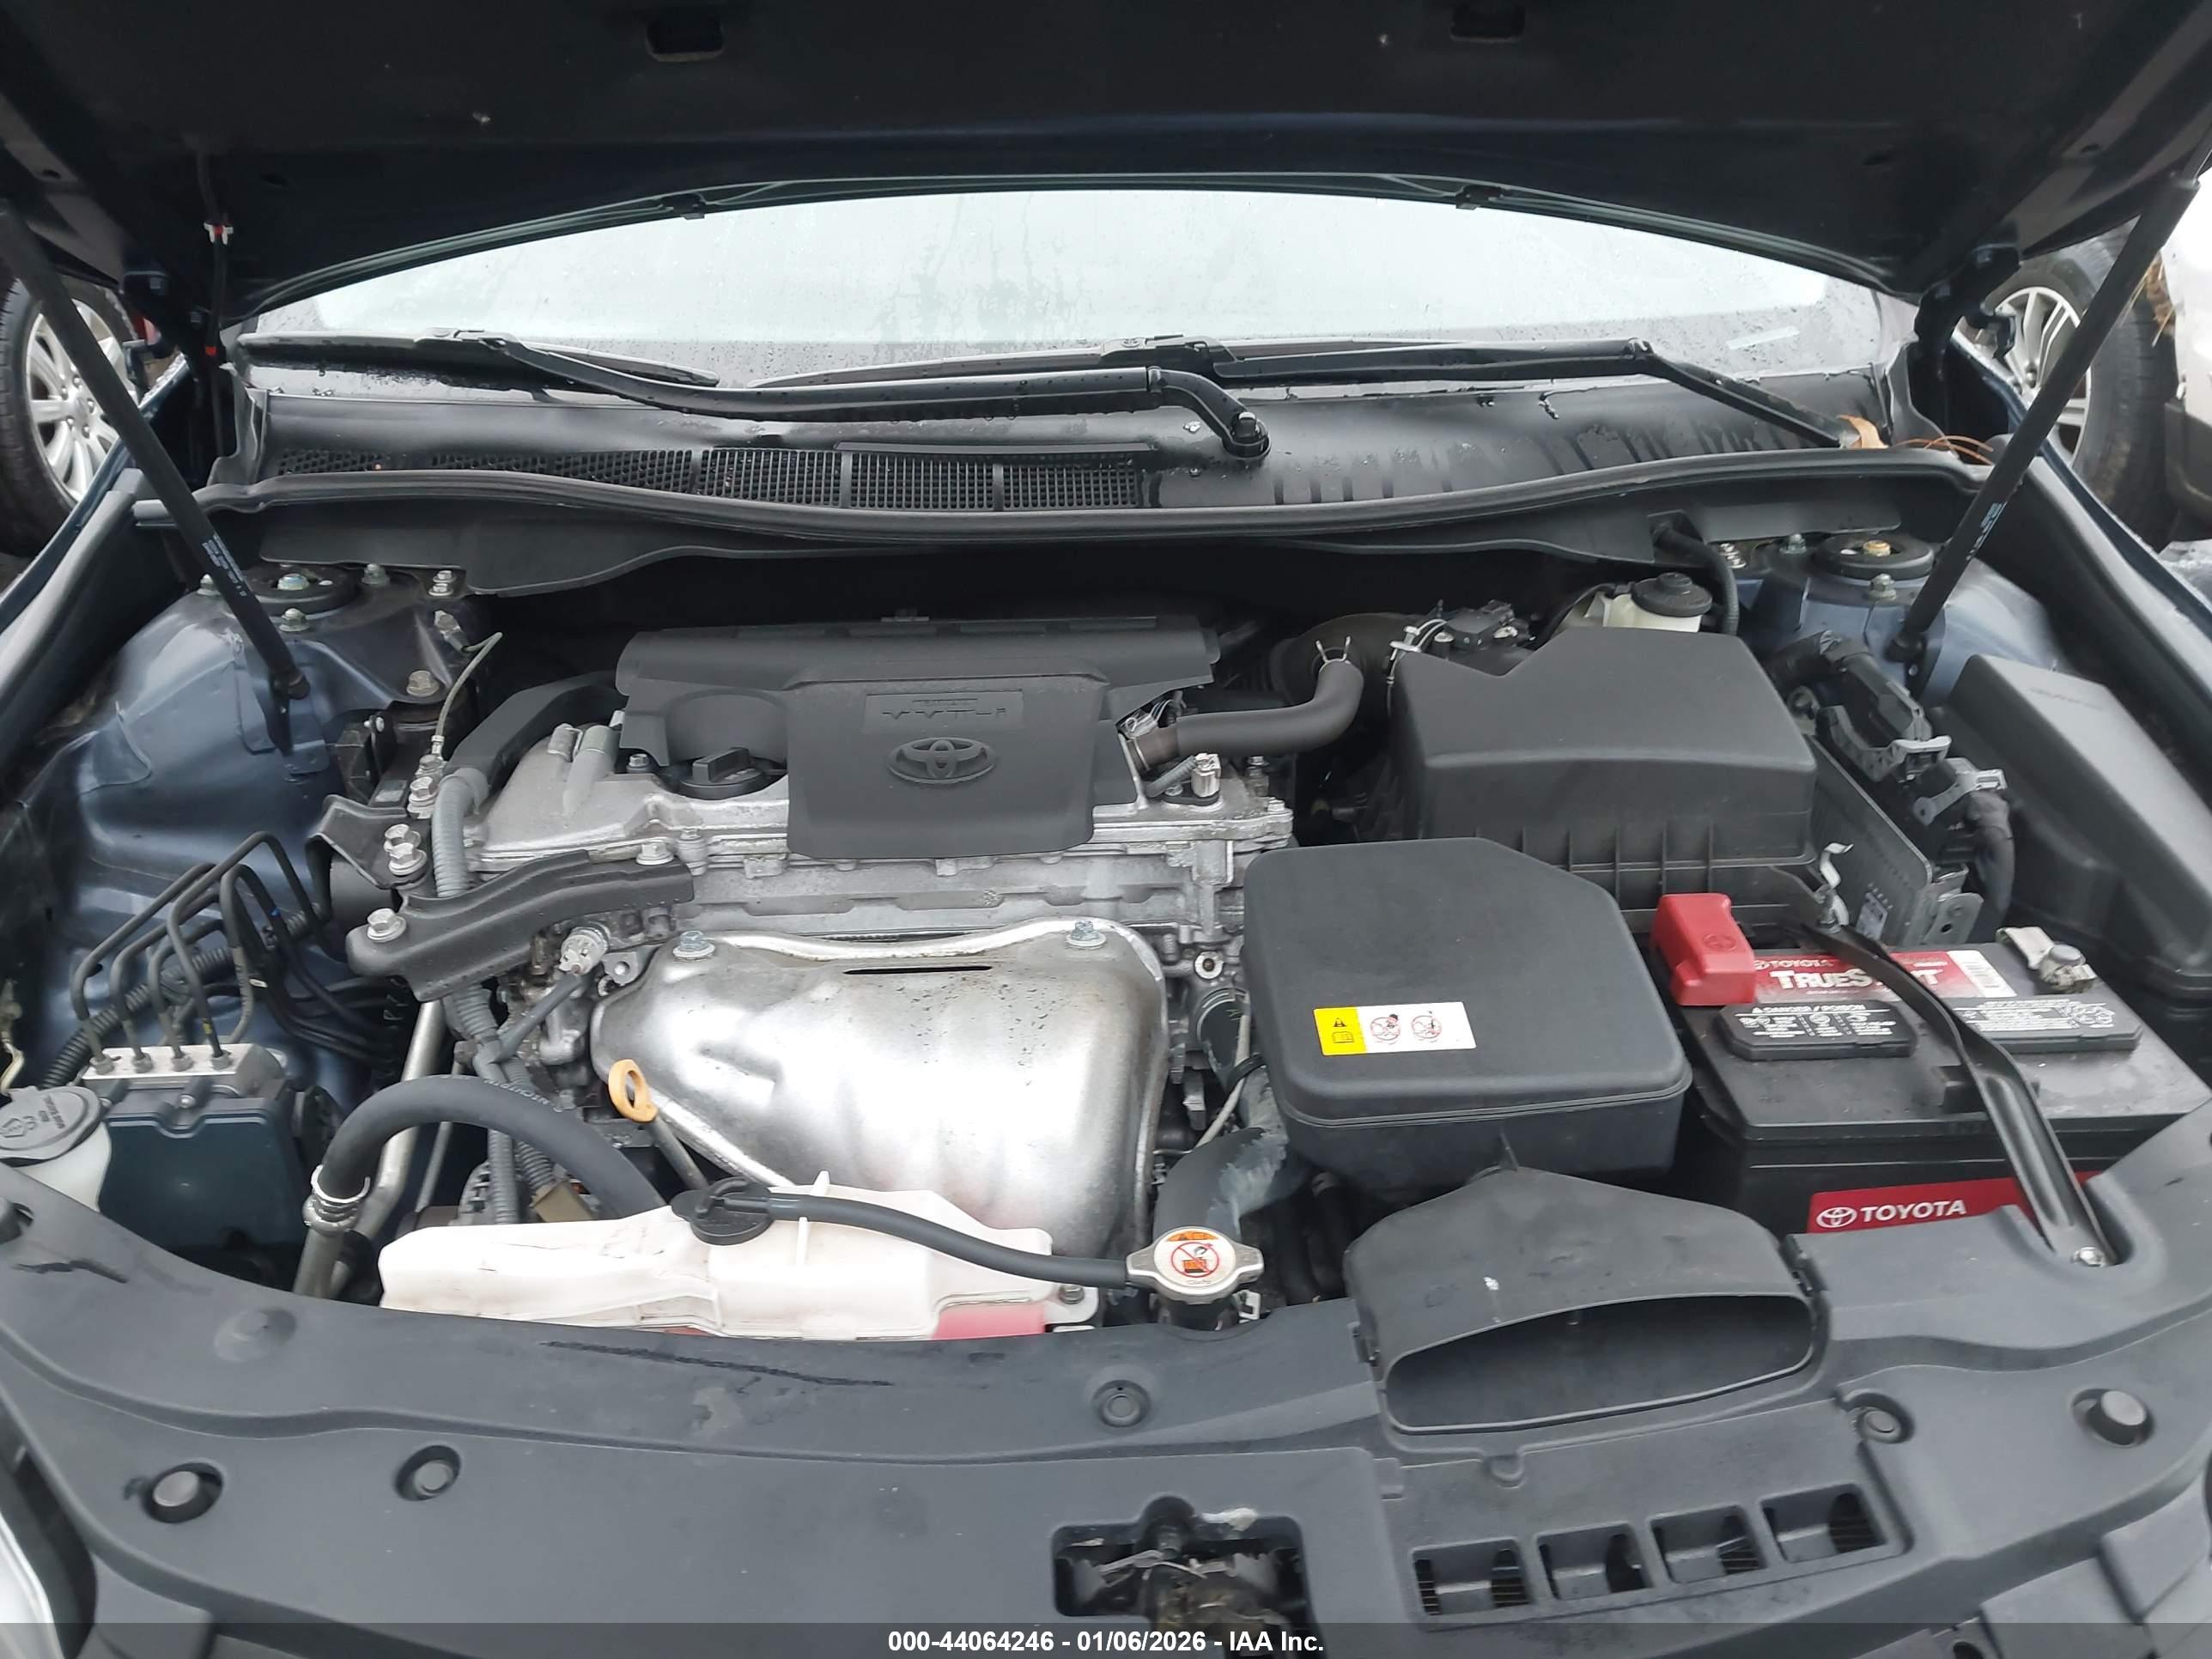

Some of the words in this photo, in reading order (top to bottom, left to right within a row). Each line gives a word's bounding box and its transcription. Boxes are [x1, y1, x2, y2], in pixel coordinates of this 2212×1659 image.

[1770, 959, 1834, 968] TOYOTA
[1770, 968, 1943, 989] TRUEST
[1860, 1200, 1966, 1223] TOYOTA
